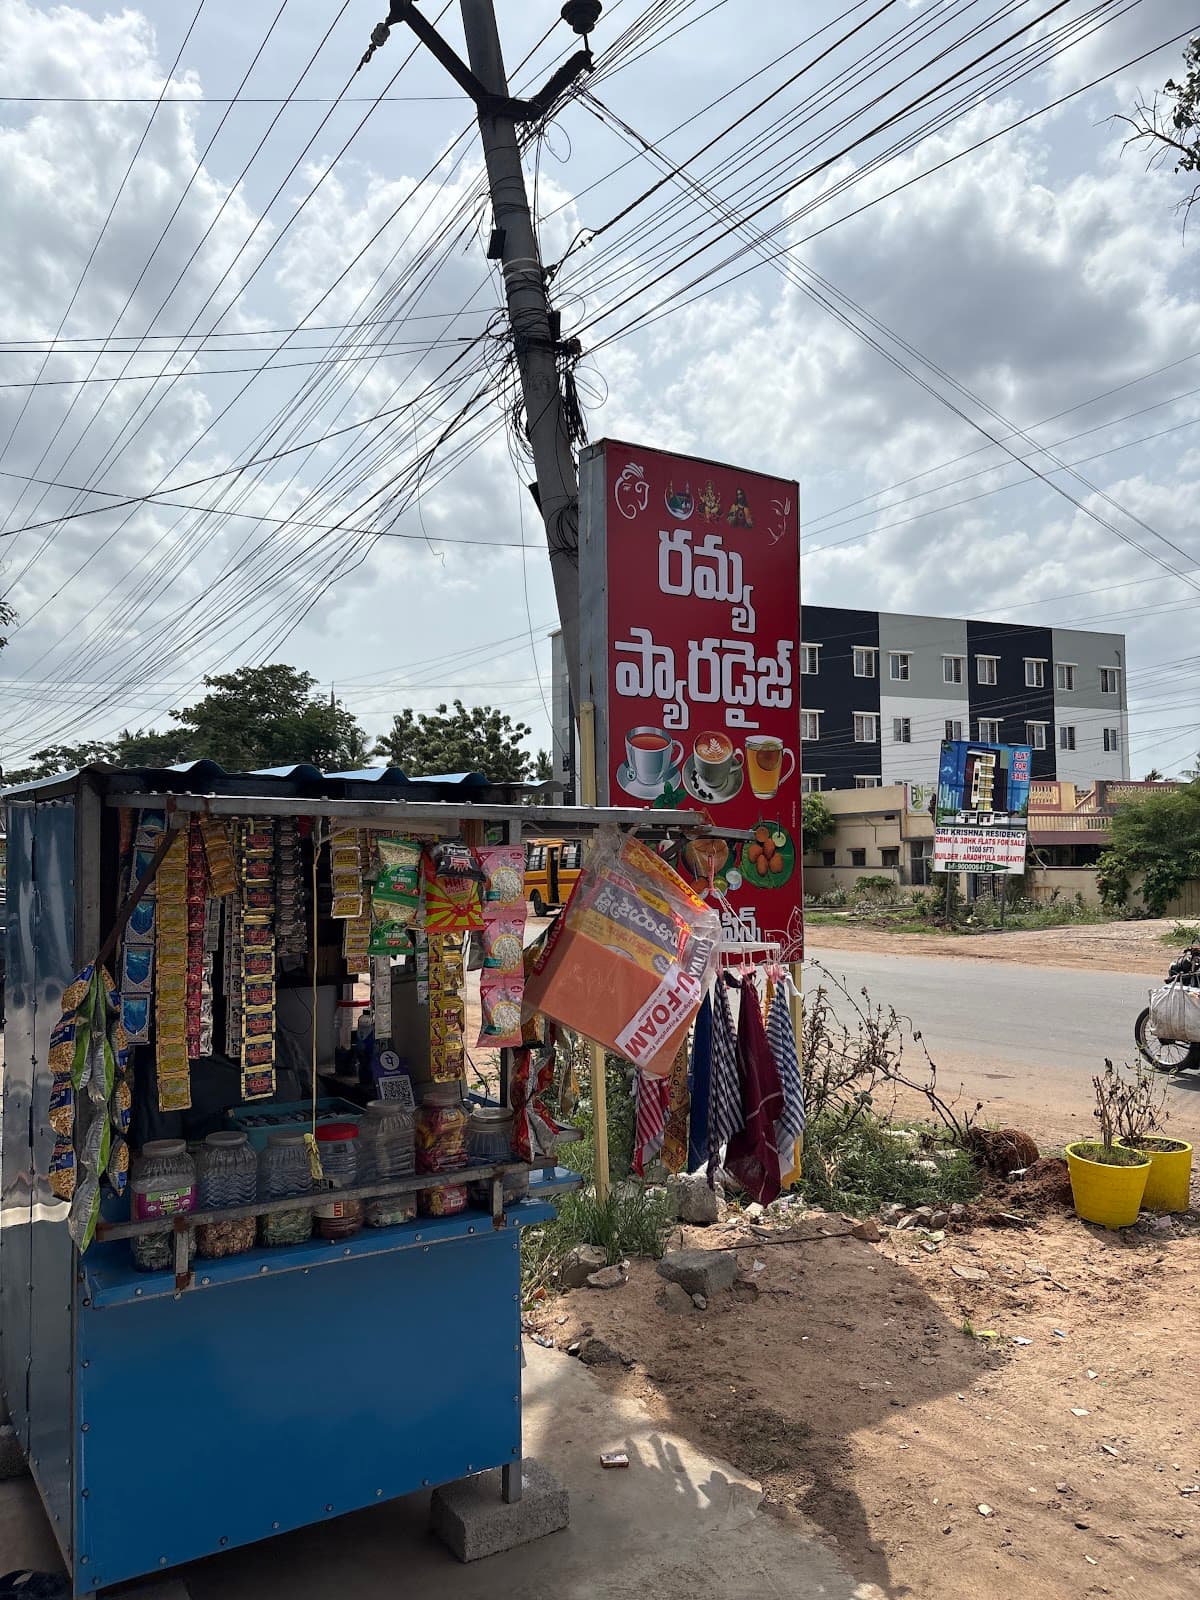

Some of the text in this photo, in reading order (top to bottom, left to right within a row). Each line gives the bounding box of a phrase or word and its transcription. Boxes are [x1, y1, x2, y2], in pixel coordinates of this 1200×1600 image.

[659, 530, 756, 634] రమ్య
[615, 627, 794, 731] ప్యారడైజ్
[1013, 752, 1029, 760] FLAT
[1014, 761, 1028, 770] FOR
[1012, 772, 1028, 781] SALE
[951, 829, 984, 837] KRISHNA
[986, 830, 1026, 839] RESIDENCY
[960, 837, 976, 845] 3BHK
[978, 838, 996, 846] FLATS
[625, 970, 696, 1059] U-FOAM
